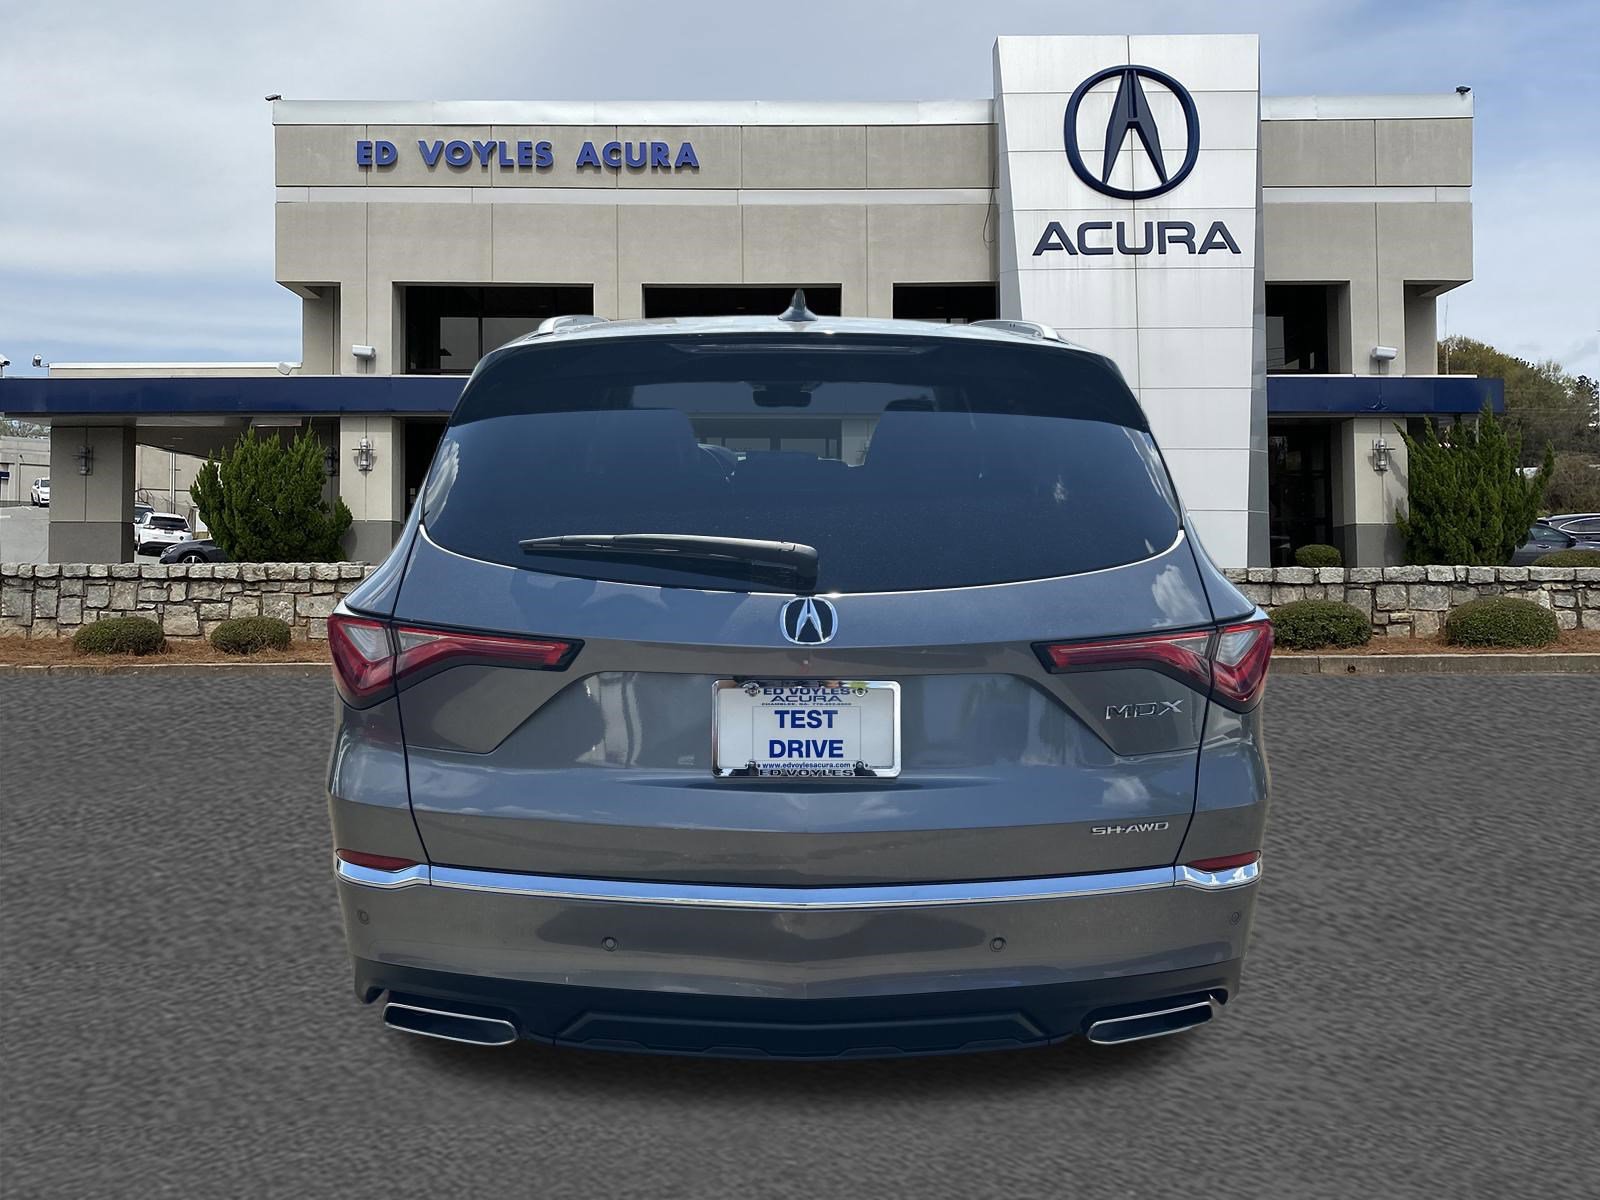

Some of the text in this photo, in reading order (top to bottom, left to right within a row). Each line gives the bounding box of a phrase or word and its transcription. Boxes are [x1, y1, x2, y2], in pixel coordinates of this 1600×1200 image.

[356, 140, 700, 168] ED VOYLES ACURA
[1032, 221, 1242, 256] ACURA
[774, 710, 839, 729] TEST
[1105, 699, 1184, 720] MDX
[769, 740, 844, 758] DRIVE
